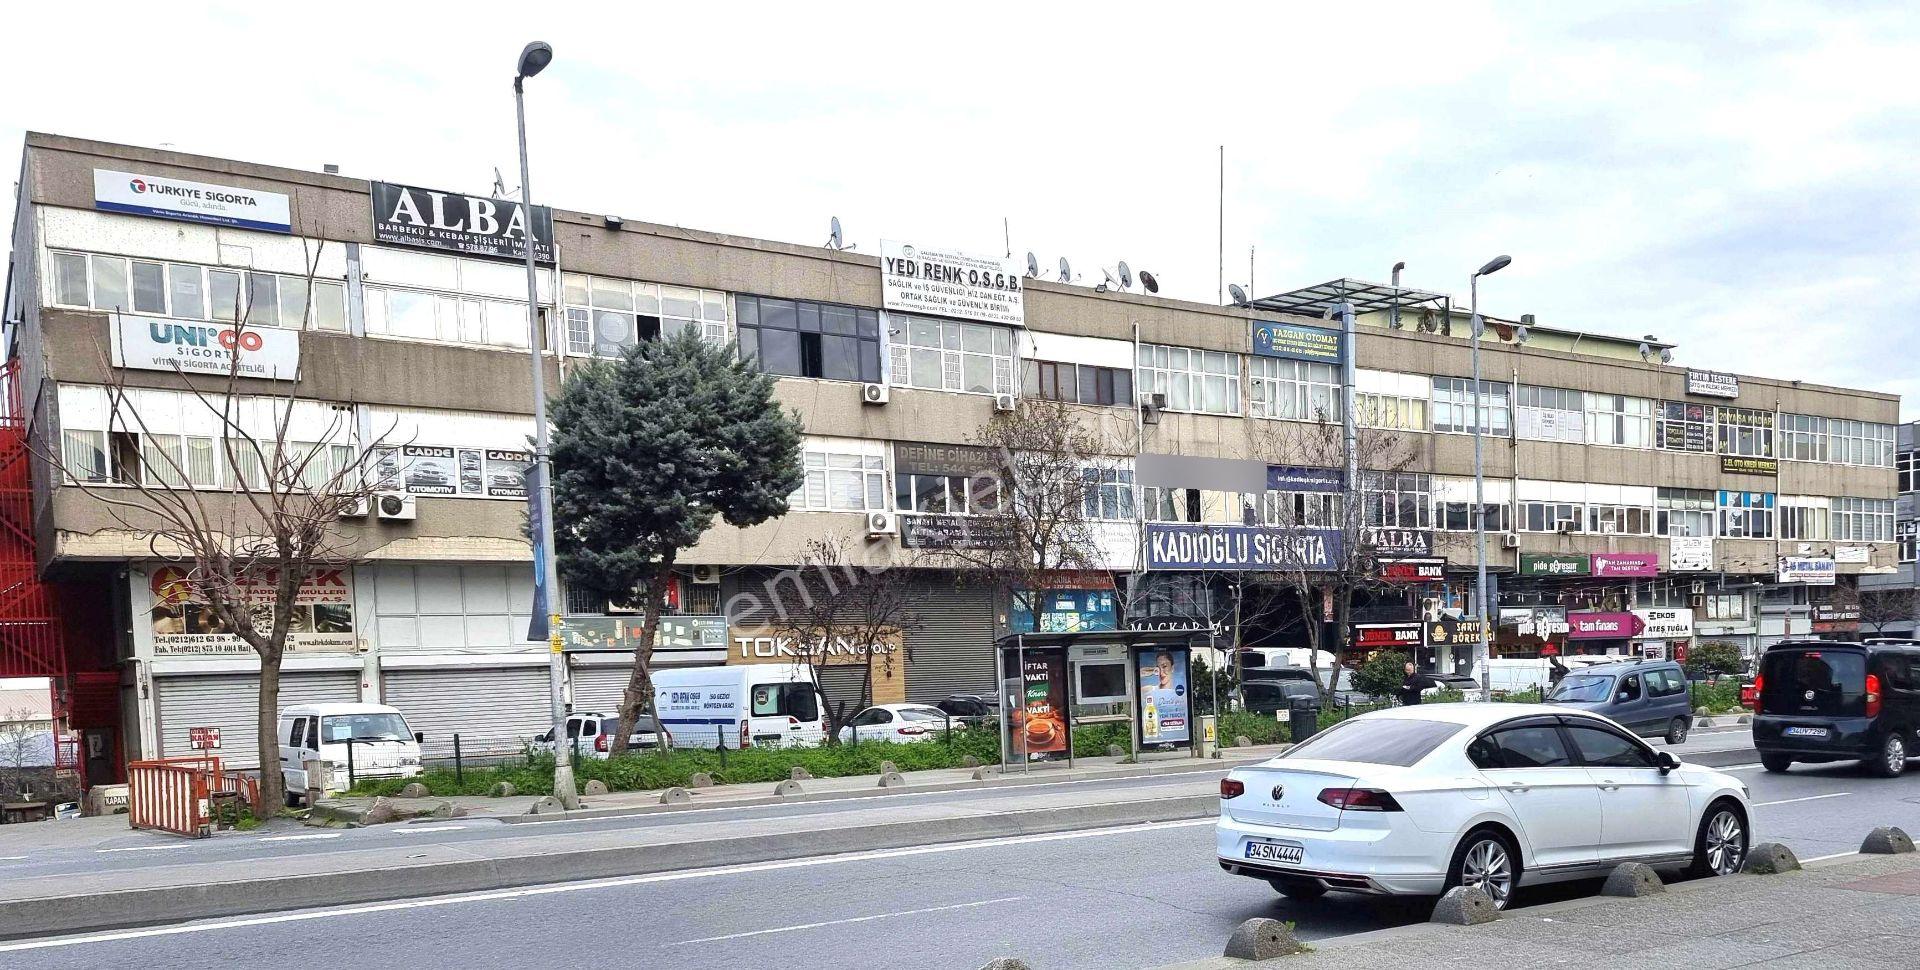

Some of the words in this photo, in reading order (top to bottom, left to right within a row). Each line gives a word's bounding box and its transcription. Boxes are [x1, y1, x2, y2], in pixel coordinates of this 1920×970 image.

[388, 187, 538, 242] ALBA
[378, 223, 425, 236] BARBEKÜ
[439, 231, 470, 241] KEBAP
[511, 238, 549, 252] İMAATI
[924, 262, 962, 283] RENK
[969, 269, 1022, 291] O.S.G.B.
[901, 292, 922, 302] ORTAK
[1272, 329, 1304, 340] YAZGAN
[1306, 333, 1338, 344] OTOMAT
[900, 445, 945, 459] DEFİNE
[910, 461, 939, 472] TEL:
[1377, 530, 1428, 548] ALBA
[1153, 528, 1249, 564] KADIOĞLU
[1418, 566, 1442, 577] BANK
[1533, 561, 1548, 573] pide
[1456, 622, 1491, 632] SARIYR
[1580, 620, 1595, 632] tam
[1595, 619, 1619, 631] finans
[1648, 625, 1666, 633] ATEŞ
[1667, 623, 1689, 632] TUĞLA
[1395, 630, 1419, 641] BANK
[857, 644, 896, 655] GOUP
[1025, 660, 1048, 671] İFTAR
[1025, 671, 1049, 682] VAKTİ
[1027, 703, 1050, 715] VAKTİ
[105, 796, 128, 806] KAPAN
